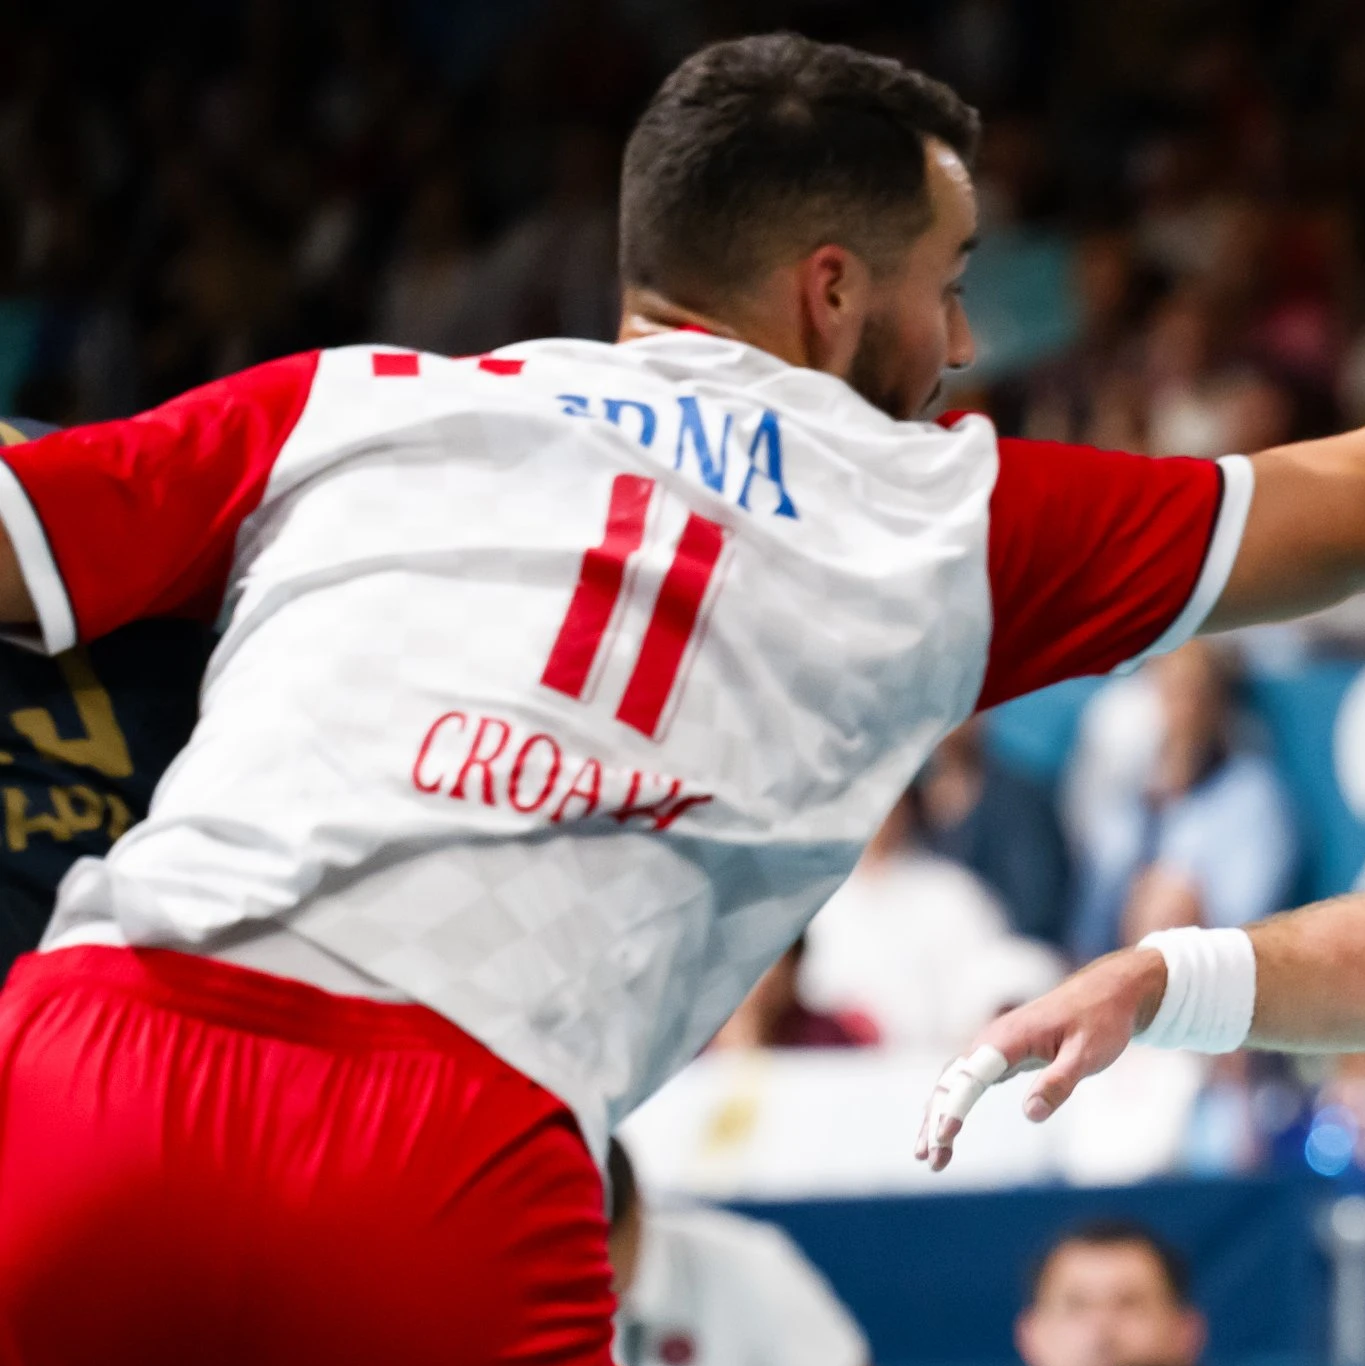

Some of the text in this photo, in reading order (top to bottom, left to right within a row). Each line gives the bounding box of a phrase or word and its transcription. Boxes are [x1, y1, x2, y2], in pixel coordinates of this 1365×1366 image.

[555, 394, 799, 520] NA
[540, 473, 733, 743] 11
[412, 709, 714, 832] CROA
